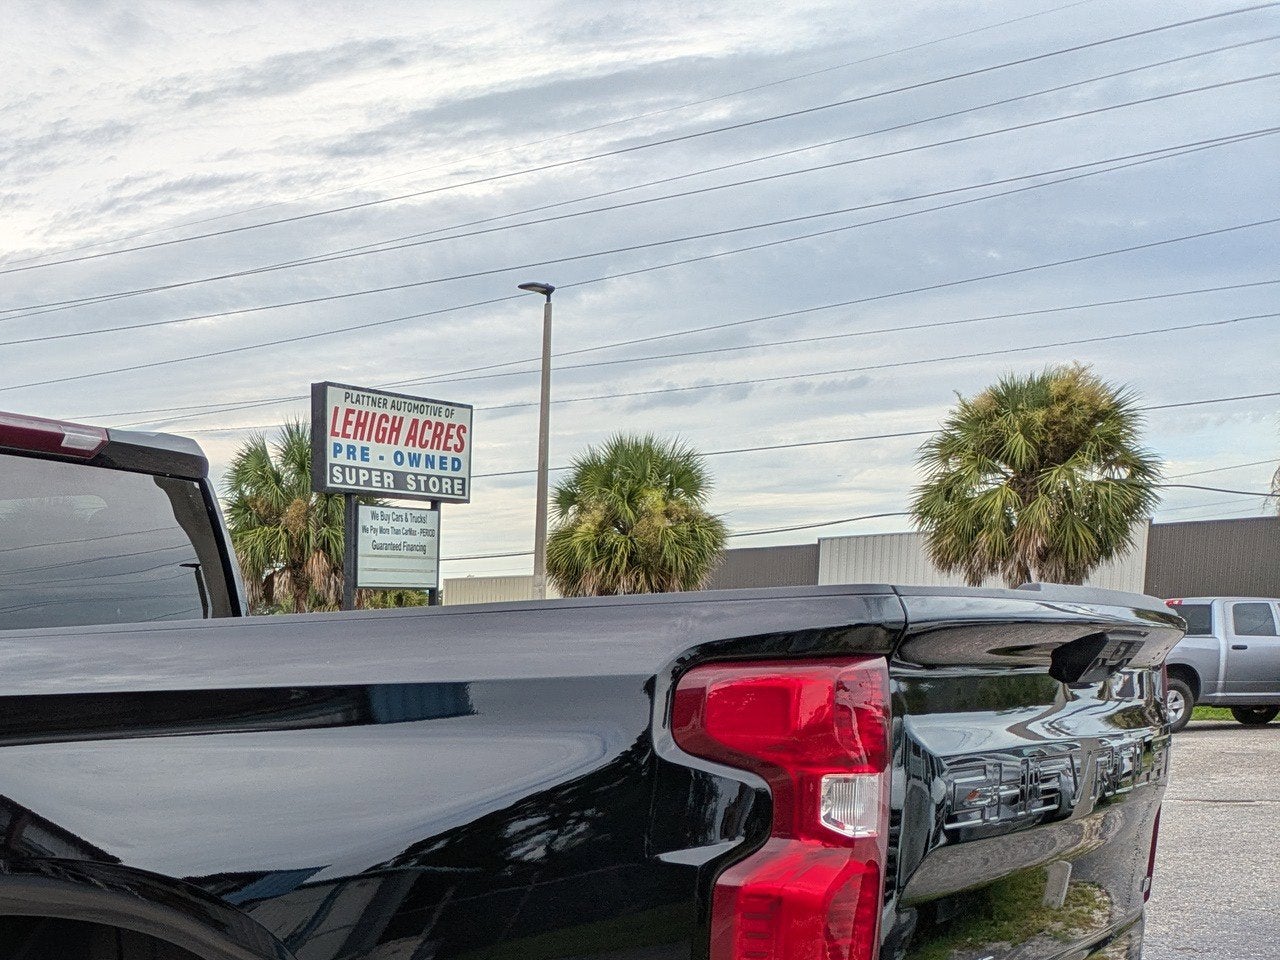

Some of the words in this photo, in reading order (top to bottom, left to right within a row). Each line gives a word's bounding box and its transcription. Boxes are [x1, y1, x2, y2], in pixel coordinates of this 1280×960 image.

[344, 391, 388, 410] PLATTNER
[390, 399, 443, 418] AUTOMOTIVE
[444, 407, 455, 419] OF
[329, 405, 405, 446] LEHIGH
[404, 417, 467, 454] ACRES
[393, 450, 462, 472] OWNED
[332, 465, 395, 489] SUPER
[406, 474, 463, 495] STORE
[370, 510, 379, 521] We
[380, 510, 390, 524] Buy
[391, 511, 404, 523] Cars
[409, 512, 428, 525] Trucks!
[361, 524, 369, 534] We
[369, 525, 378, 536] Pay
[379, 526, 390, 535] More
[390, 526, 402, 535] Than
[419, 528, 436, 538] PERIOD
[371, 539, 402, 552] Guaranteed
[402, 541, 427, 555] Financing
